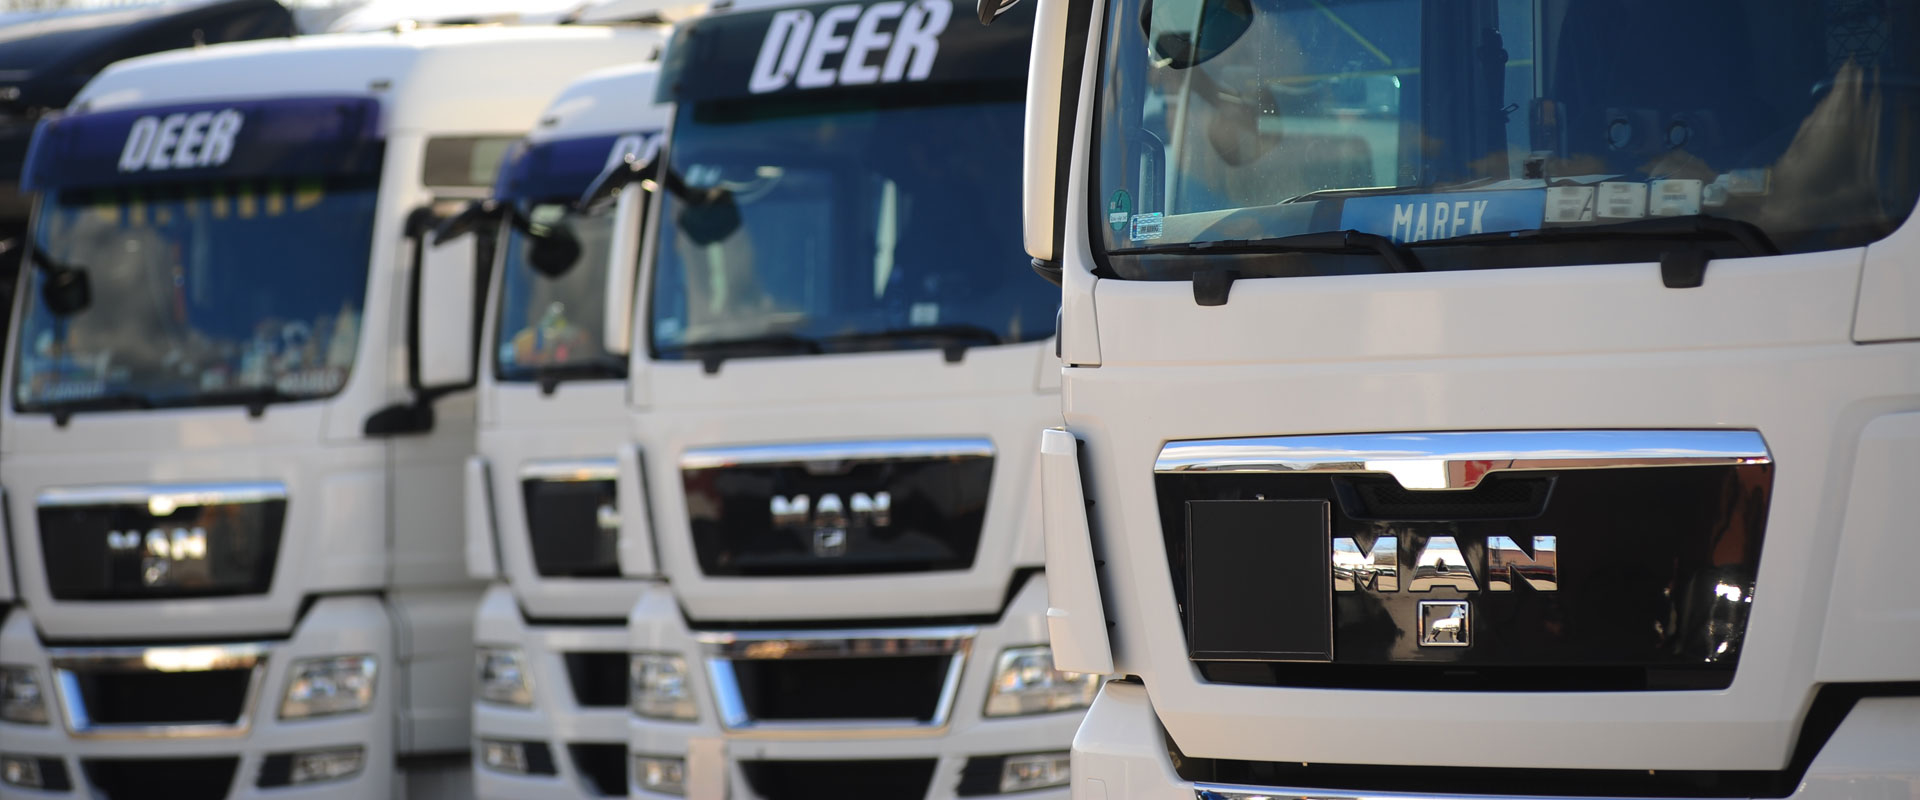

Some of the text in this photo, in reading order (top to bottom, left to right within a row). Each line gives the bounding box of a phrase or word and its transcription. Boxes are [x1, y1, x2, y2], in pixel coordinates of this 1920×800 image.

[748, 0, 953, 93] DEER
[118, 108, 244, 173] DEER
[1116, 192, 1123, 210] 4
[770, 491, 891, 526] MAN
[1333, 536, 1558, 592] MAN
